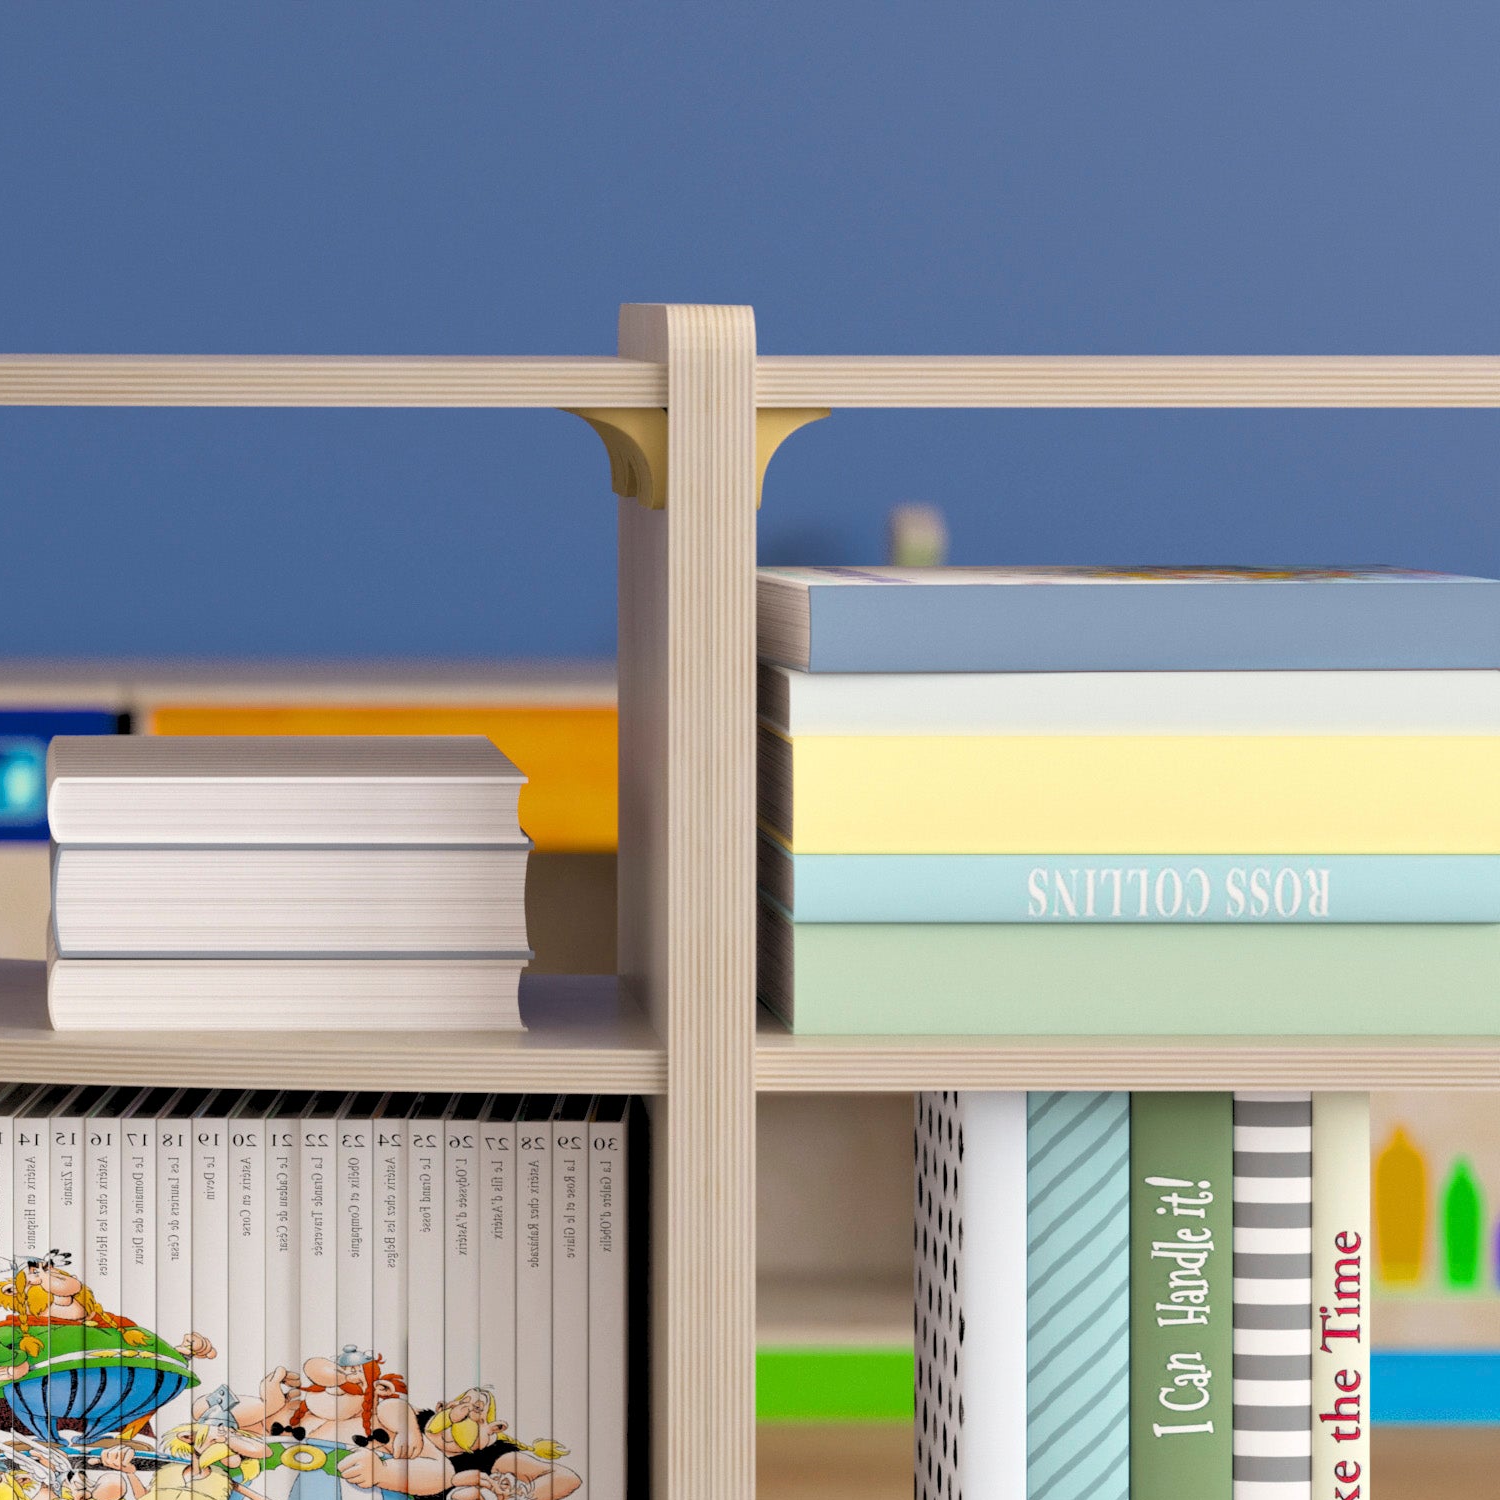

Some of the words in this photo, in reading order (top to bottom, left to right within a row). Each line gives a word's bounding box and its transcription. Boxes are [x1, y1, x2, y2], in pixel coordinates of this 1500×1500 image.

[1027, 867, 1210, 917] COLLINS
[1225, 867, 1330, 917] ROSS
[1144, 1176, 1214, 1219] it!
[1150, 1227, 1214, 1327] Handle
[1320, 1231, 1361, 1354] Time
[1158, 1351, 1212, 1412] Can
[1319, 1369, 1361, 1443] the
[1153, 1420, 1214, 1438] I
